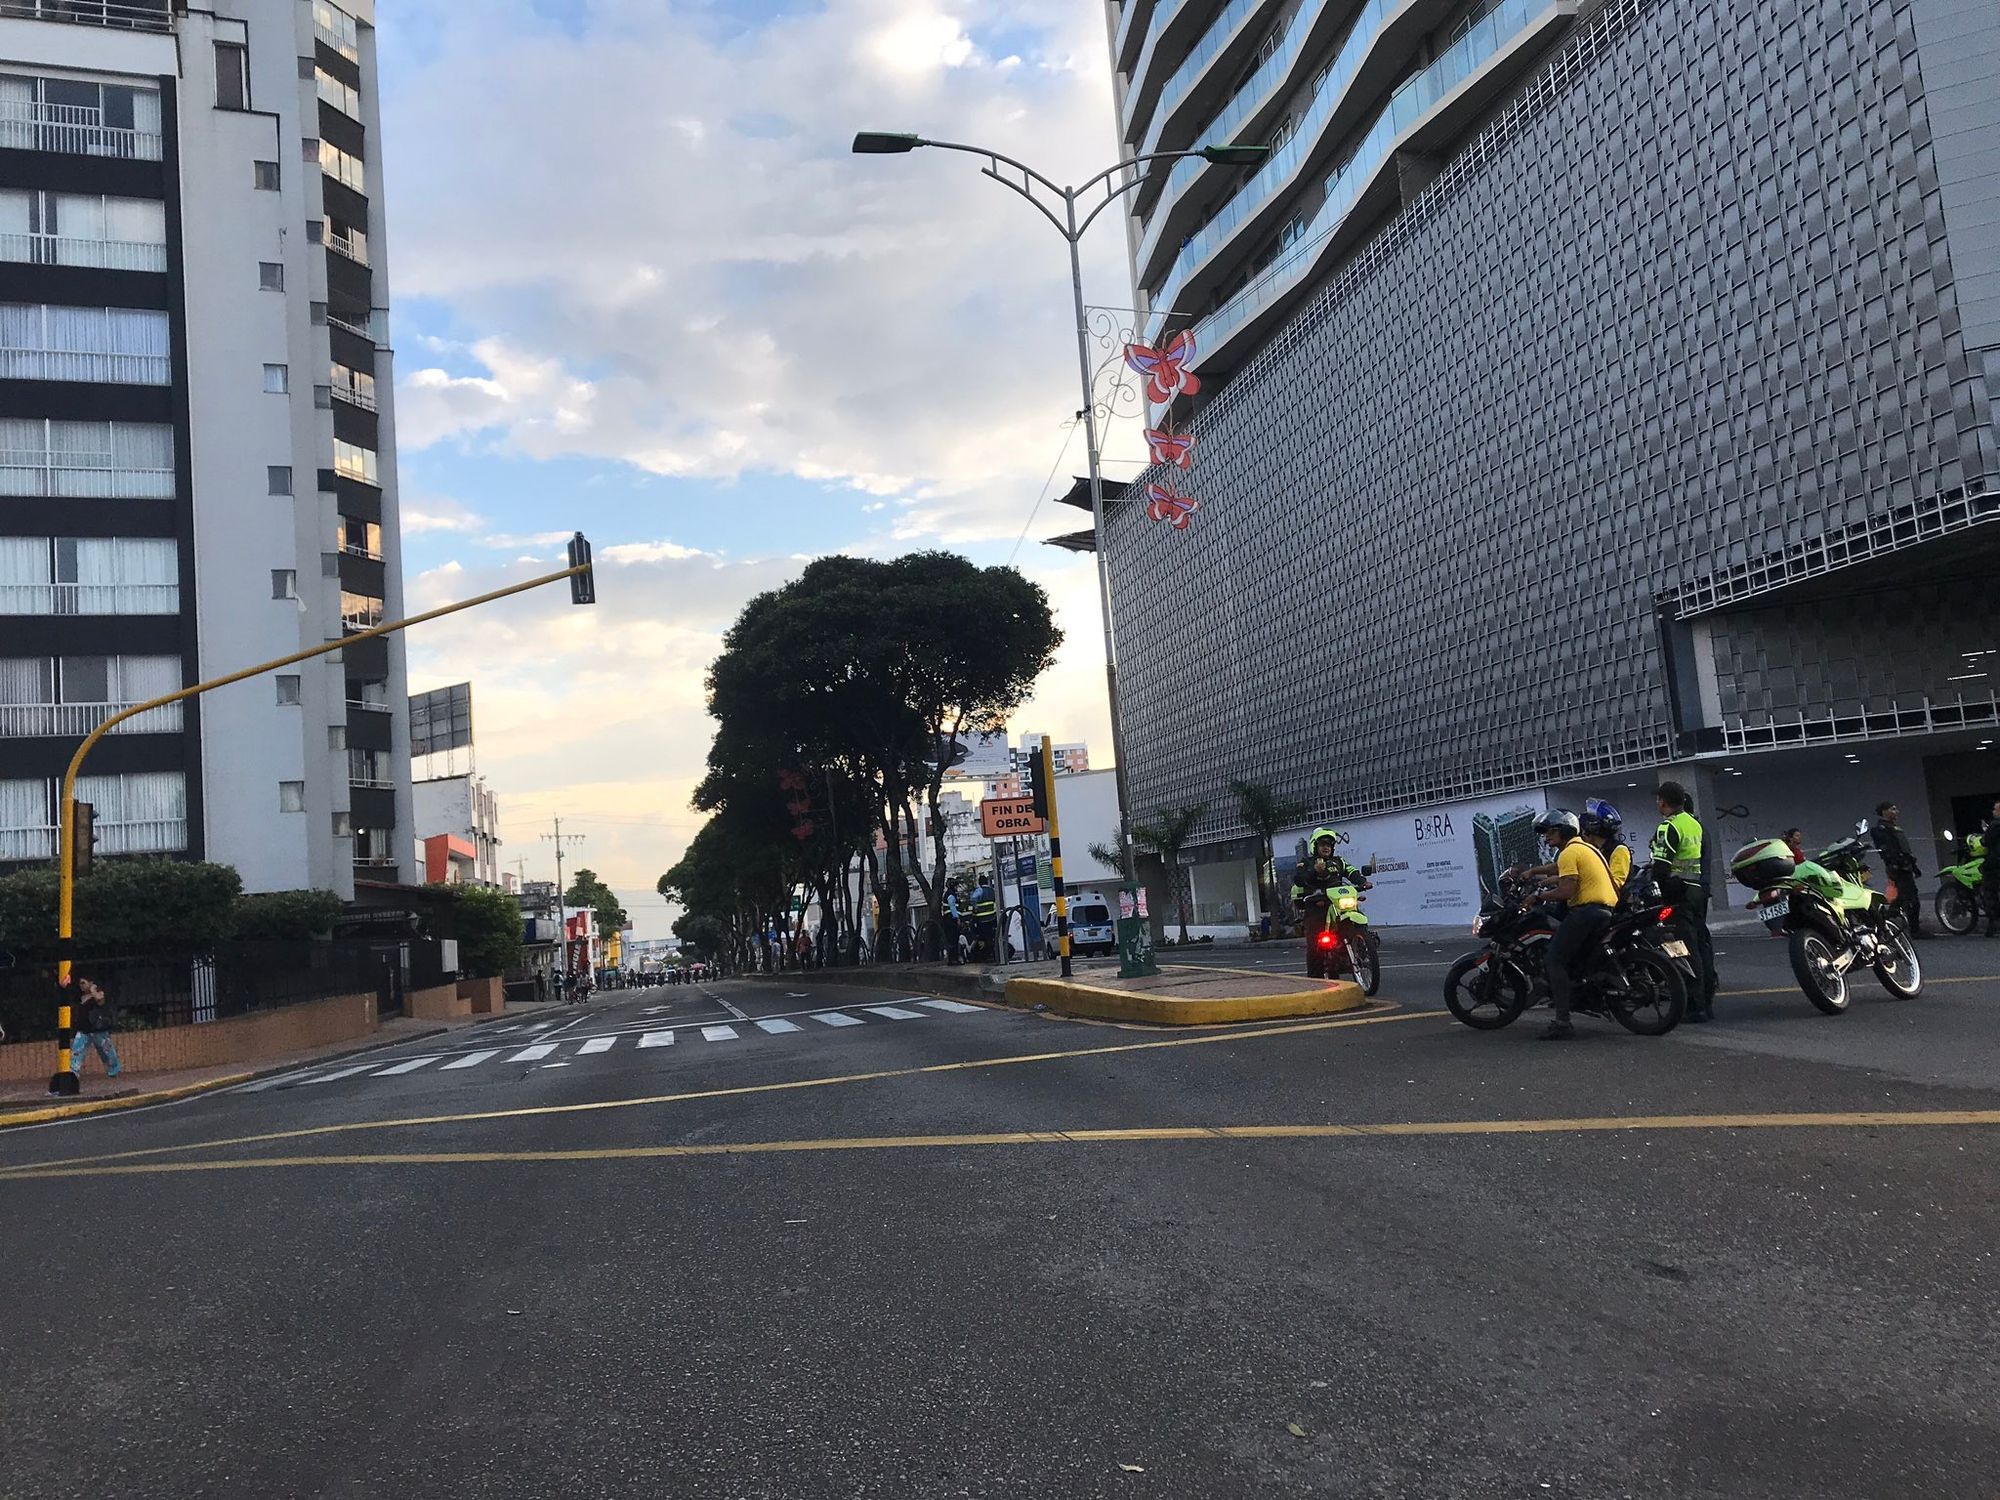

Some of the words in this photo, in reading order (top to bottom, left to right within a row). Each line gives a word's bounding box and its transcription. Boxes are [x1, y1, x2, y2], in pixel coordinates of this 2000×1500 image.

[992, 805, 1012, 815] FIN
[1016, 804, 1032, 814] DE
[996, 817, 1031, 828] OBRA
